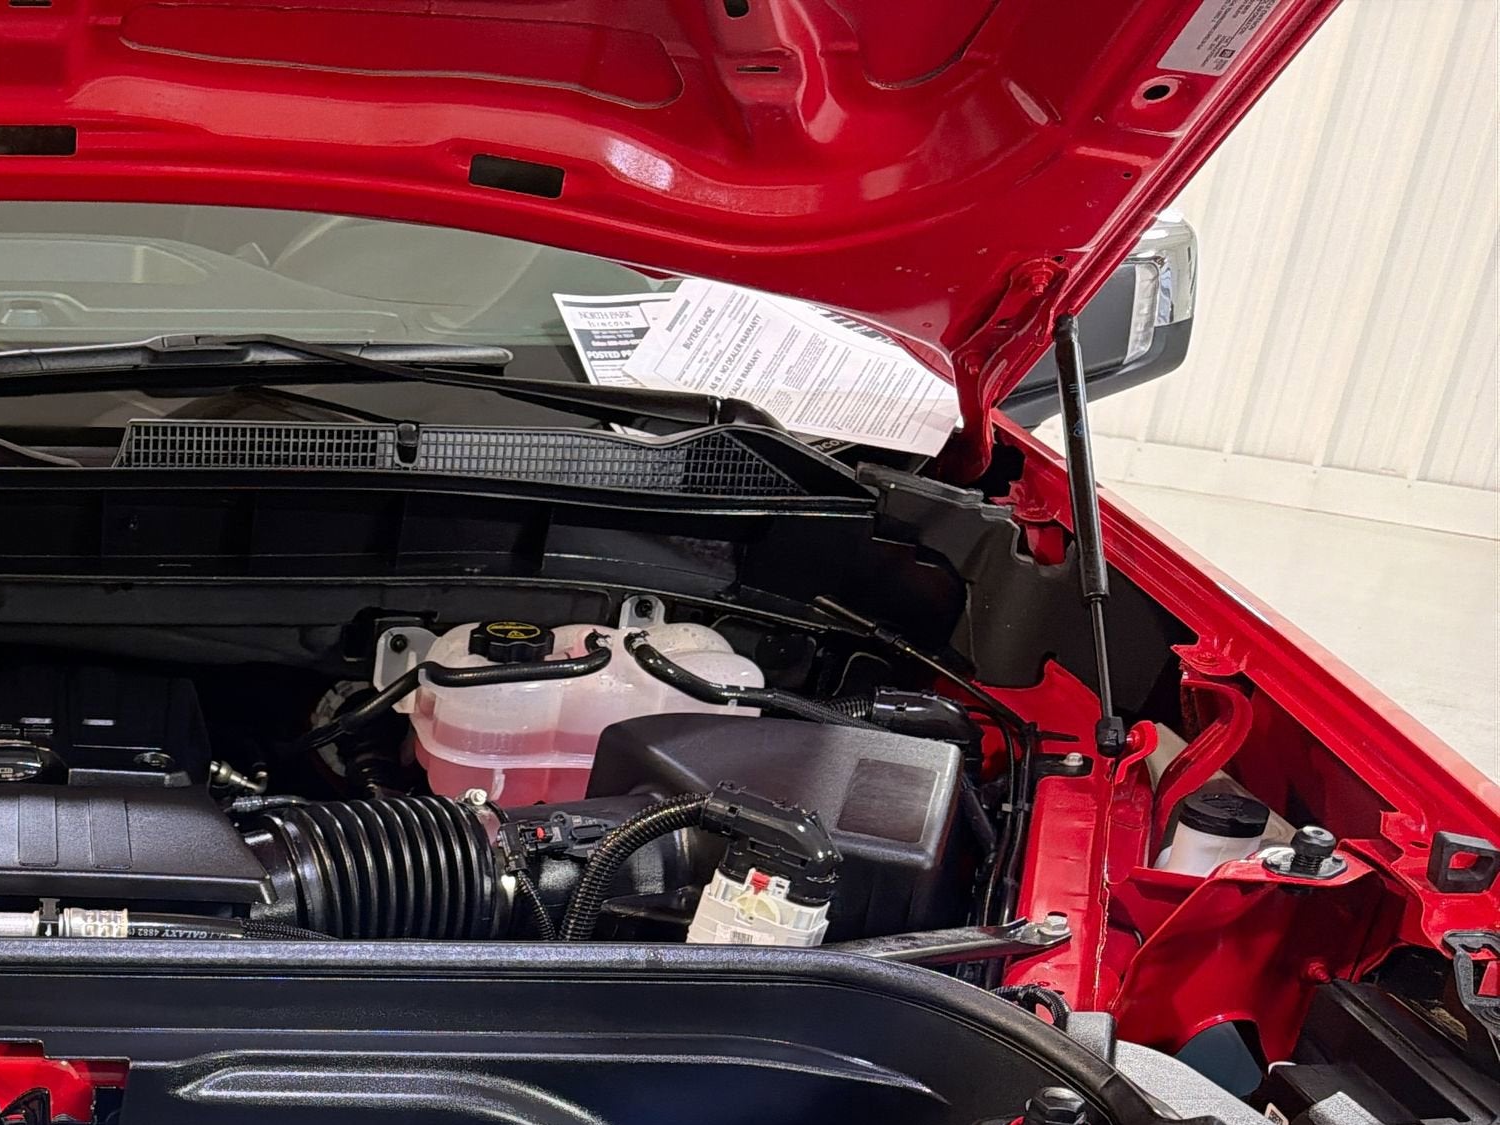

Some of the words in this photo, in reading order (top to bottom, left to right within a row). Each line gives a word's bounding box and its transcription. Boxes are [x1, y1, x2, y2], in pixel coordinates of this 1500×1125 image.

[578, 311, 607, 320] NORTH
[609, 311, 633, 319] PARK
[587, 320, 631, 328] LINCOLN
[682, 323, 703, 350] BUYERS
[697, 305, 715, 326] GUIDE
[586, 350, 620, 359] POSTED
[708, 380, 718, 391] AS
[719, 363, 729, 375] NO
[724, 342, 743, 365] DEALER
[738, 313, 762, 344] WARRANTY
[726, 376, 744, 399] EALER
[740, 348, 762, 378] WARRANTY
[137, 928, 159, 936] 4882
[162, 929, 208, 939] GALAXY
